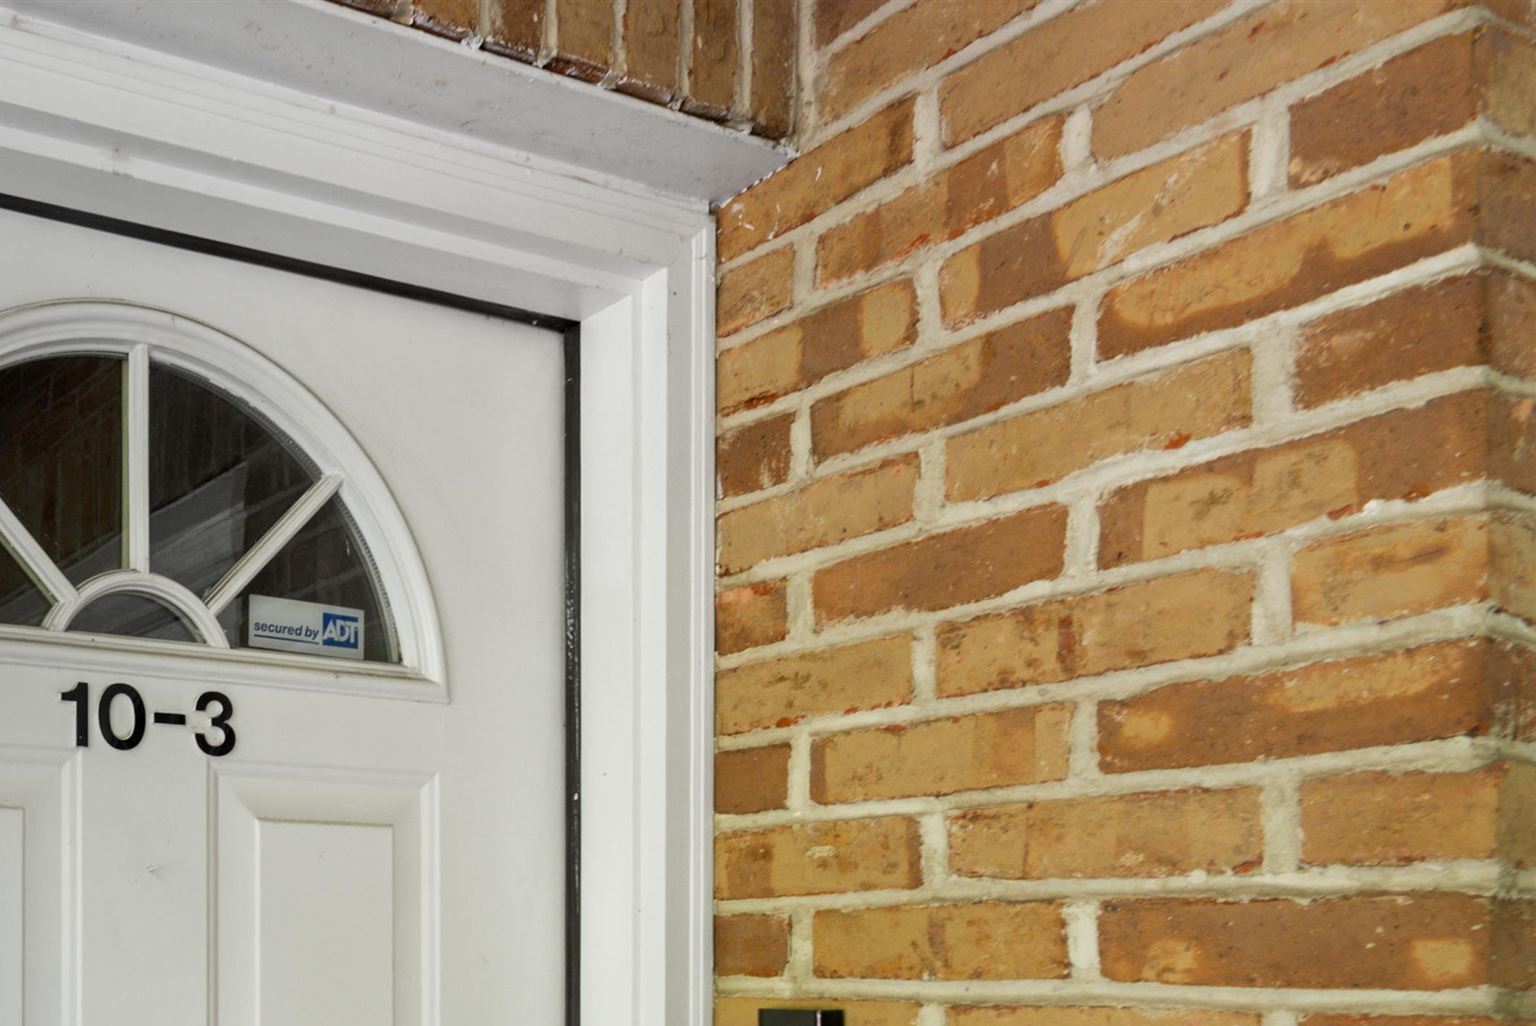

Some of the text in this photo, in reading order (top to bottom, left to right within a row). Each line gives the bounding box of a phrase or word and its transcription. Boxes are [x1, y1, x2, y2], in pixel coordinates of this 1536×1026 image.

[254, 618, 358, 644] secured by ADT
[61, 682, 236, 757] 10-3
